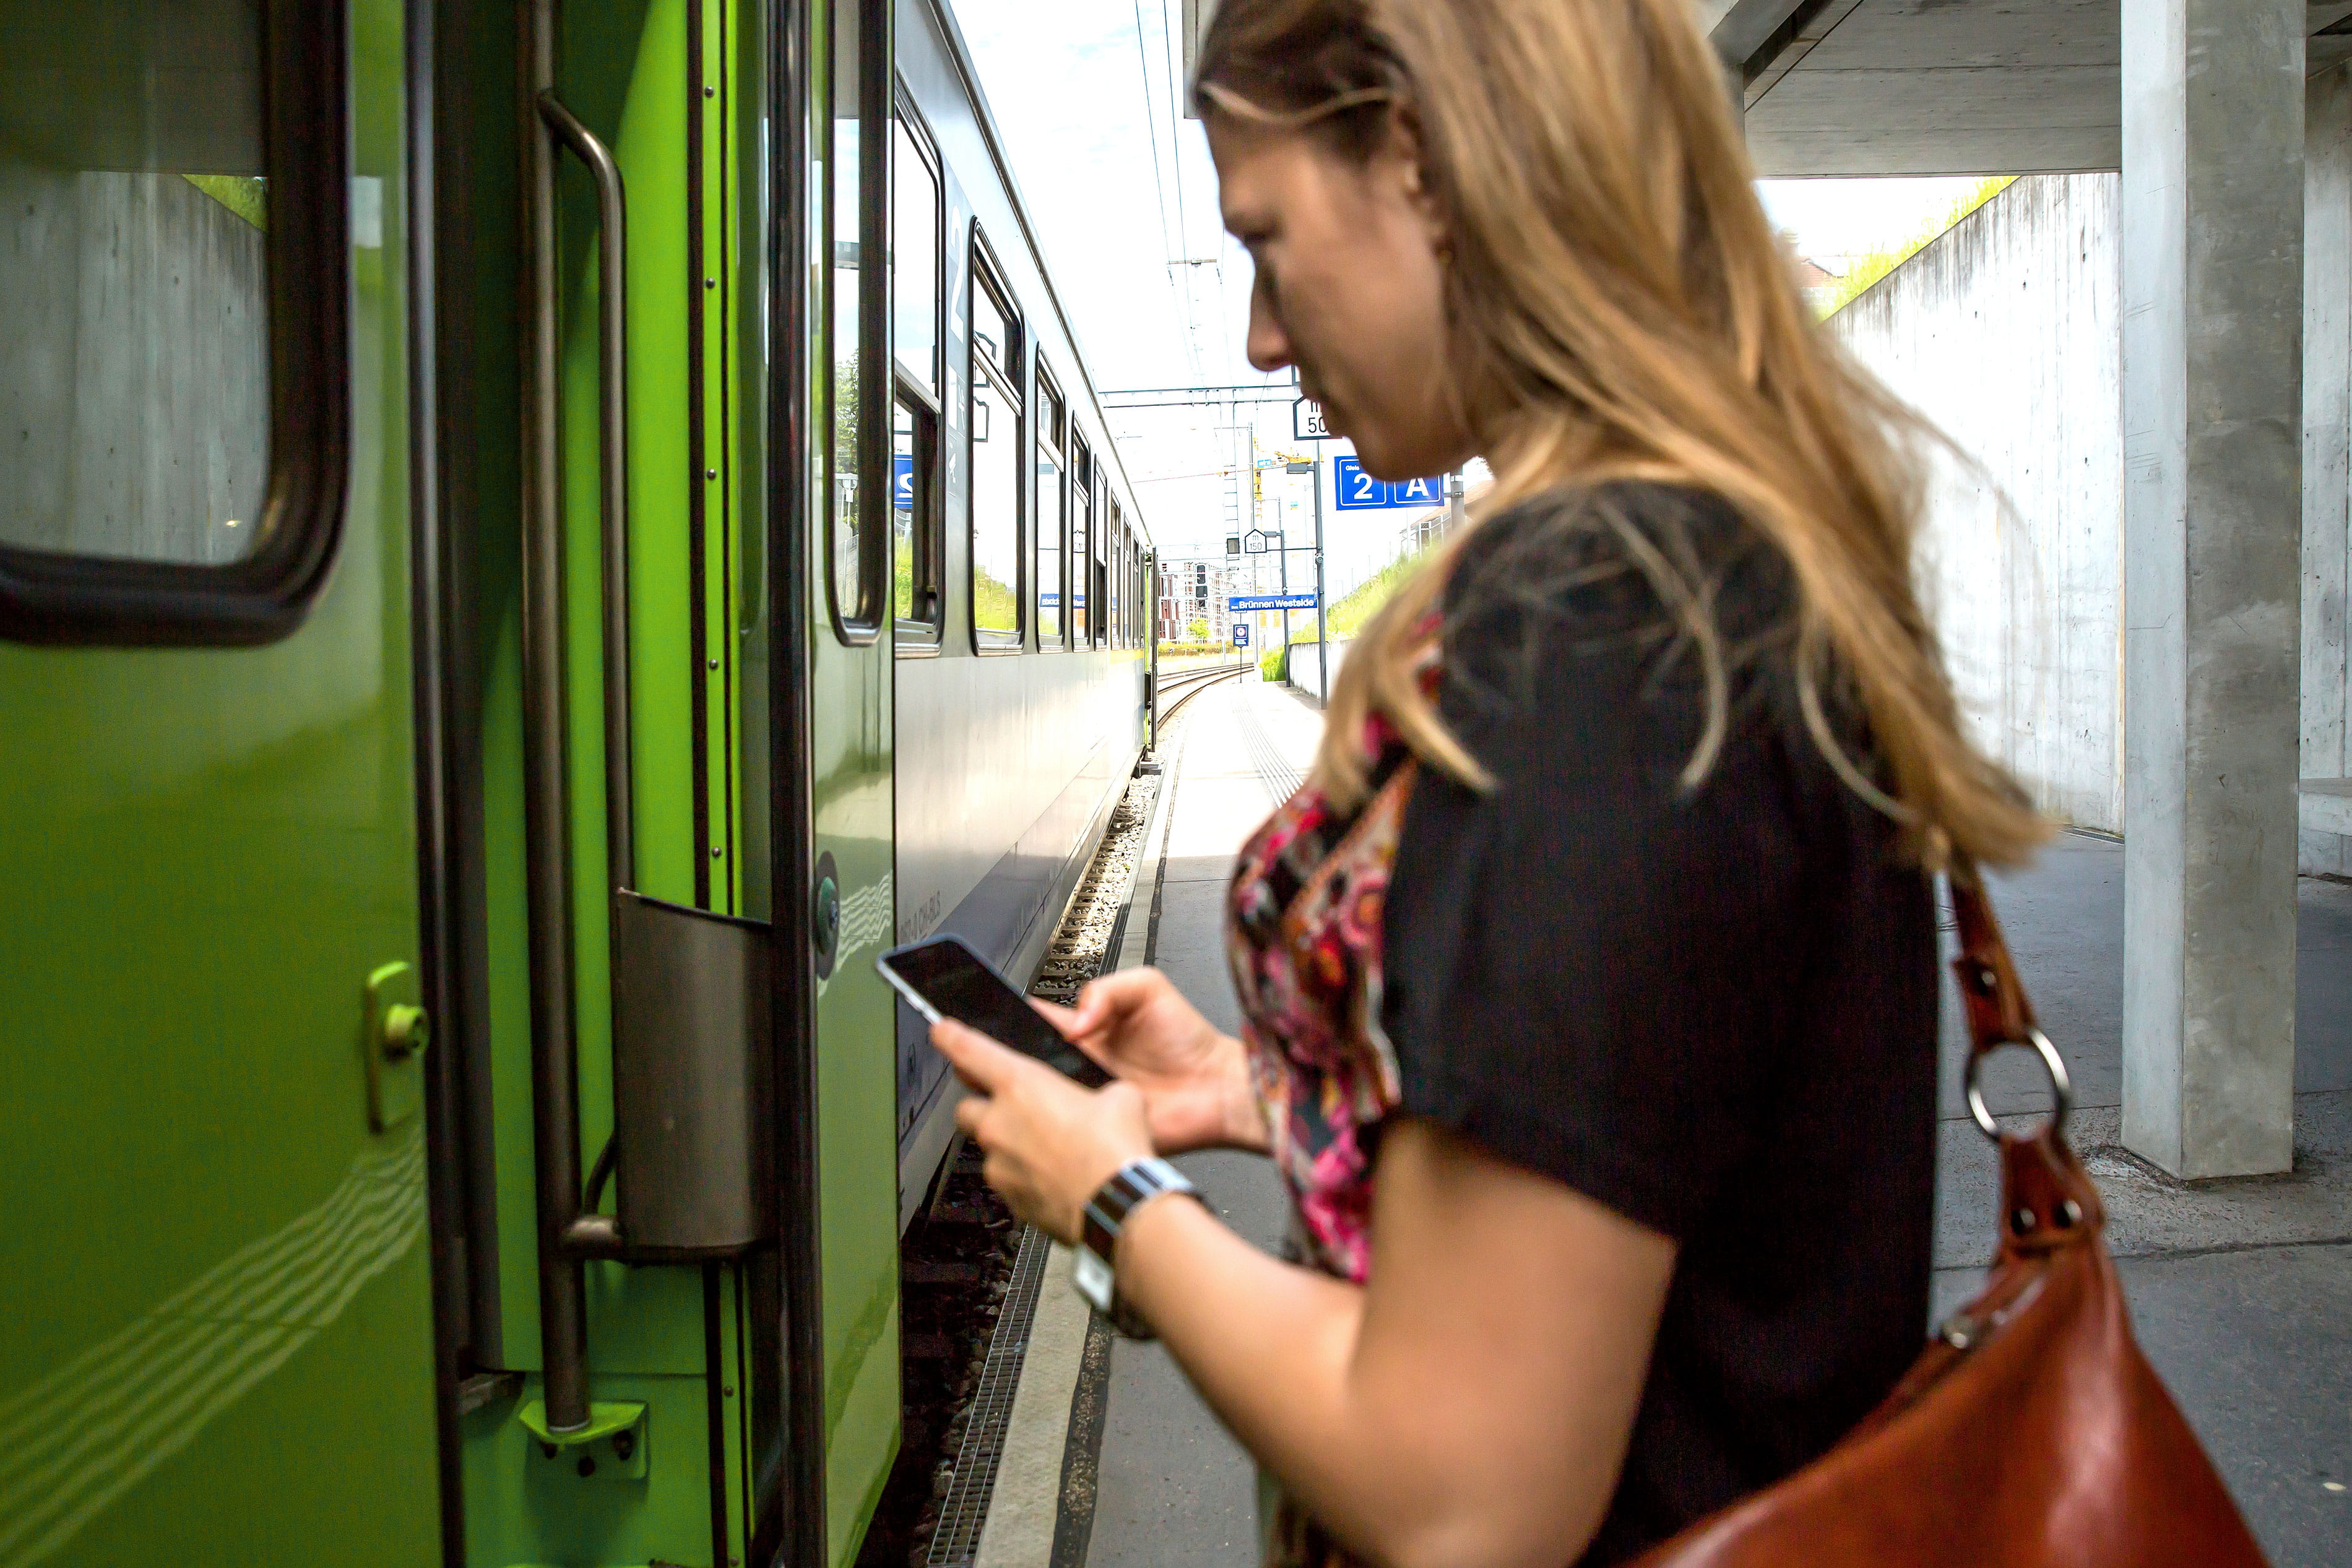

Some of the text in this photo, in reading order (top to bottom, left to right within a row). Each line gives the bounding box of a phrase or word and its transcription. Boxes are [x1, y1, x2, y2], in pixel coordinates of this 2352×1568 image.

[1308, 416, 1327, 433] 50
[1354, 473, 1430, 500] 2 A
[1250, 543, 1262, 551] 150
[1239, 601, 1274, 609] Brünnen
[1275, 598, 1314, 608] Westside
